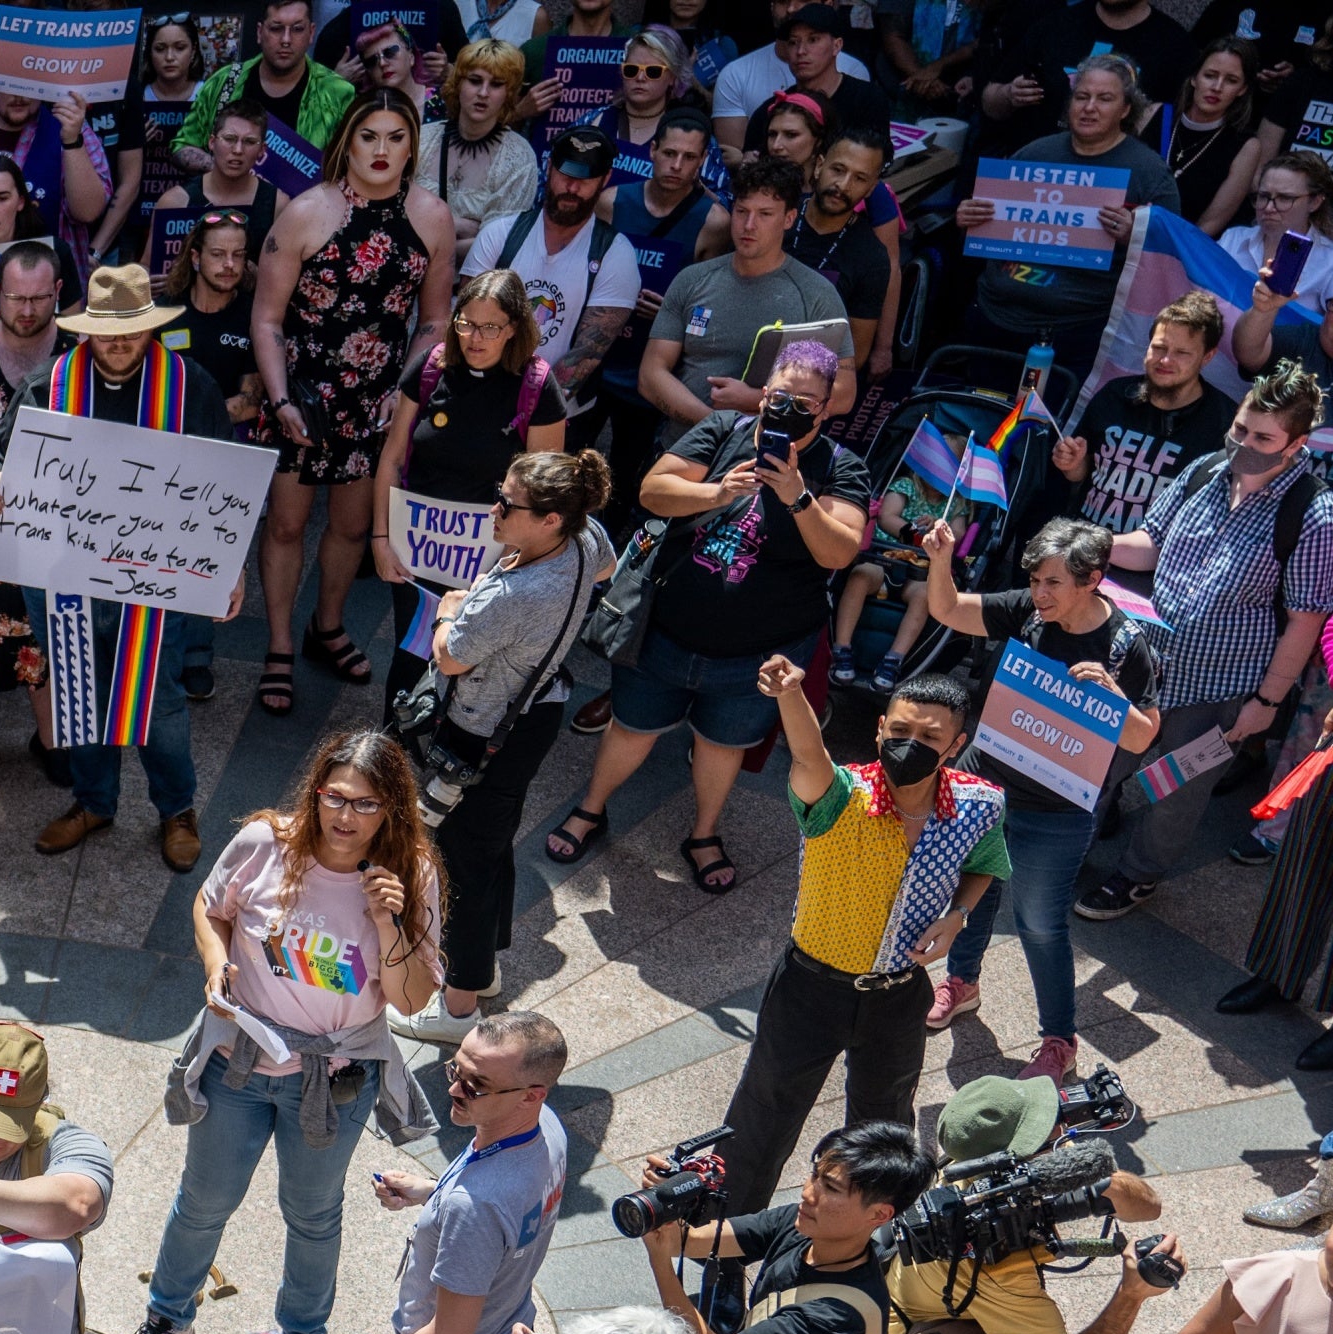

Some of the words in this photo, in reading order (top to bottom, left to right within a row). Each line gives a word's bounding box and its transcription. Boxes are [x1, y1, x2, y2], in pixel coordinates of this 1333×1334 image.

[0, 16, 35, 33] LET
[36, 19, 93, 38] TRANS
[95, 19, 135, 36] KIDS
[21, 55, 78, 74] GROW
[80, 57, 103, 73] UP
[557, 48, 625, 65] ORGANIZE
[555, 68, 572, 84] TO
[264, 129, 321, 179] ORGANIZE
[1009, 166, 1096, 188] LISTEN
[1034, 187, 1064, 205] TO
[1005, 206, 1084, 227] TRANS
[1013, 227, 1070, 247] KIDS
[845, 385, 885, 440] PROTECT
[1101, 426, 1183, 474] SELF
[20, 429, 97, 497] Truly
[119, 459, 156, 493] I
[165, 464, 217, 502] tell
[117, 513, 163, 536] you
[180, 511, 200, 533] do
[213, 519, 238, 545] to
[406, 499, 489, 540] TRUST
[140, 543, 158, 563] do
[166, 547, 187, 568] to
[407, 530, 486, 584] YOUTH
[1002, 653, 1034, 681] LET
[1032, 667, 1084, 708] TRANS
[1082, 695, 1122, 729] KIDS
[1011, 708, 1063, 746] GROW
[1060, 735, 1084, 758] UP
[269, 923, 359, 966] PRIDE
[308, 960, 347, 978] BIGGER
[673, 1178, 701, 1196] RØDE
